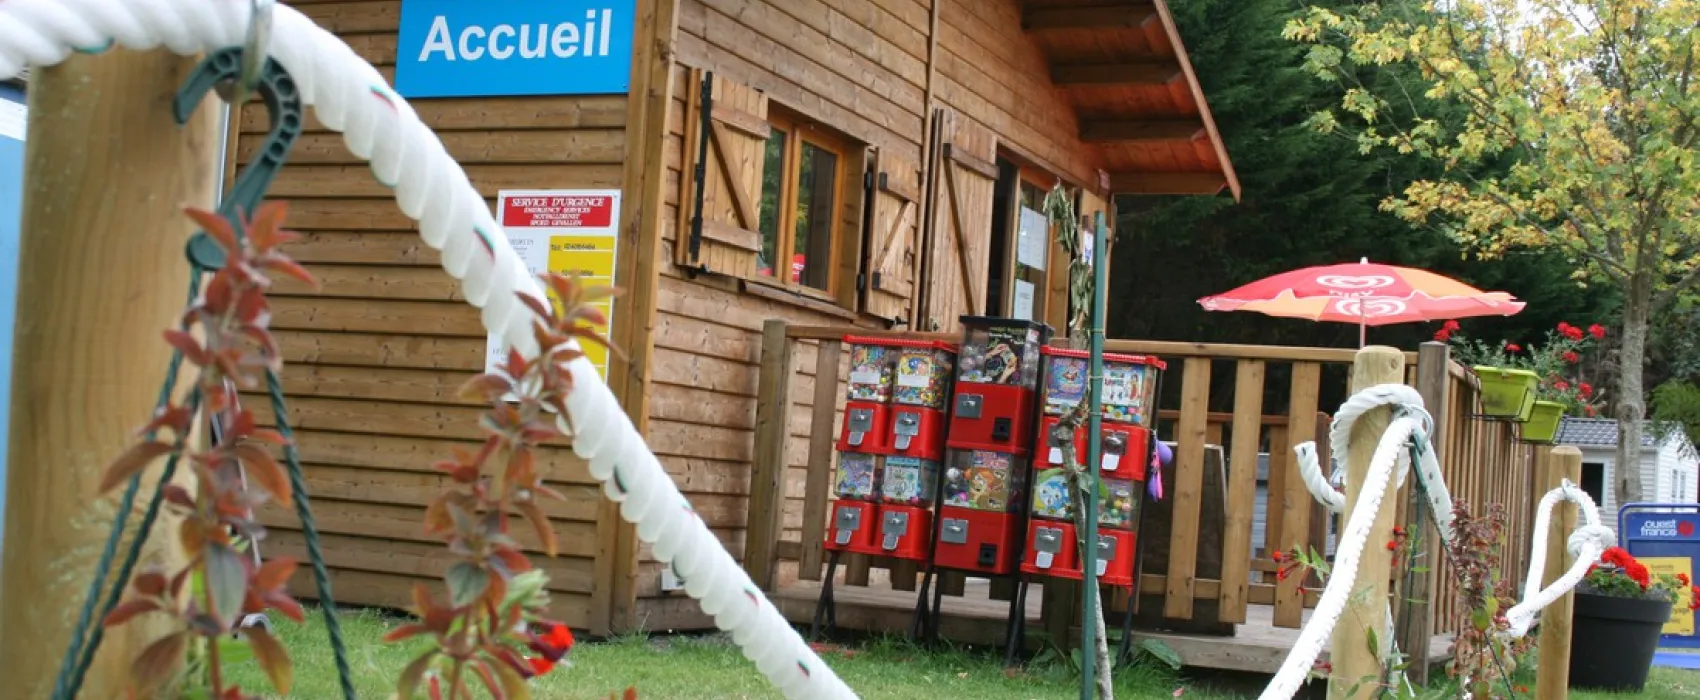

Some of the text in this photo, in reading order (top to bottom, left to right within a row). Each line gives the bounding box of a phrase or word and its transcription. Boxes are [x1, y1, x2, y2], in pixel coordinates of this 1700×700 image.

[418, 8, 612, 61] Accueil
[511, 197, 605, 207] SERVICE D'URGENCE
[1644, 519, 1676, 528] ouest
[1640, 526, 1678, 537] france
